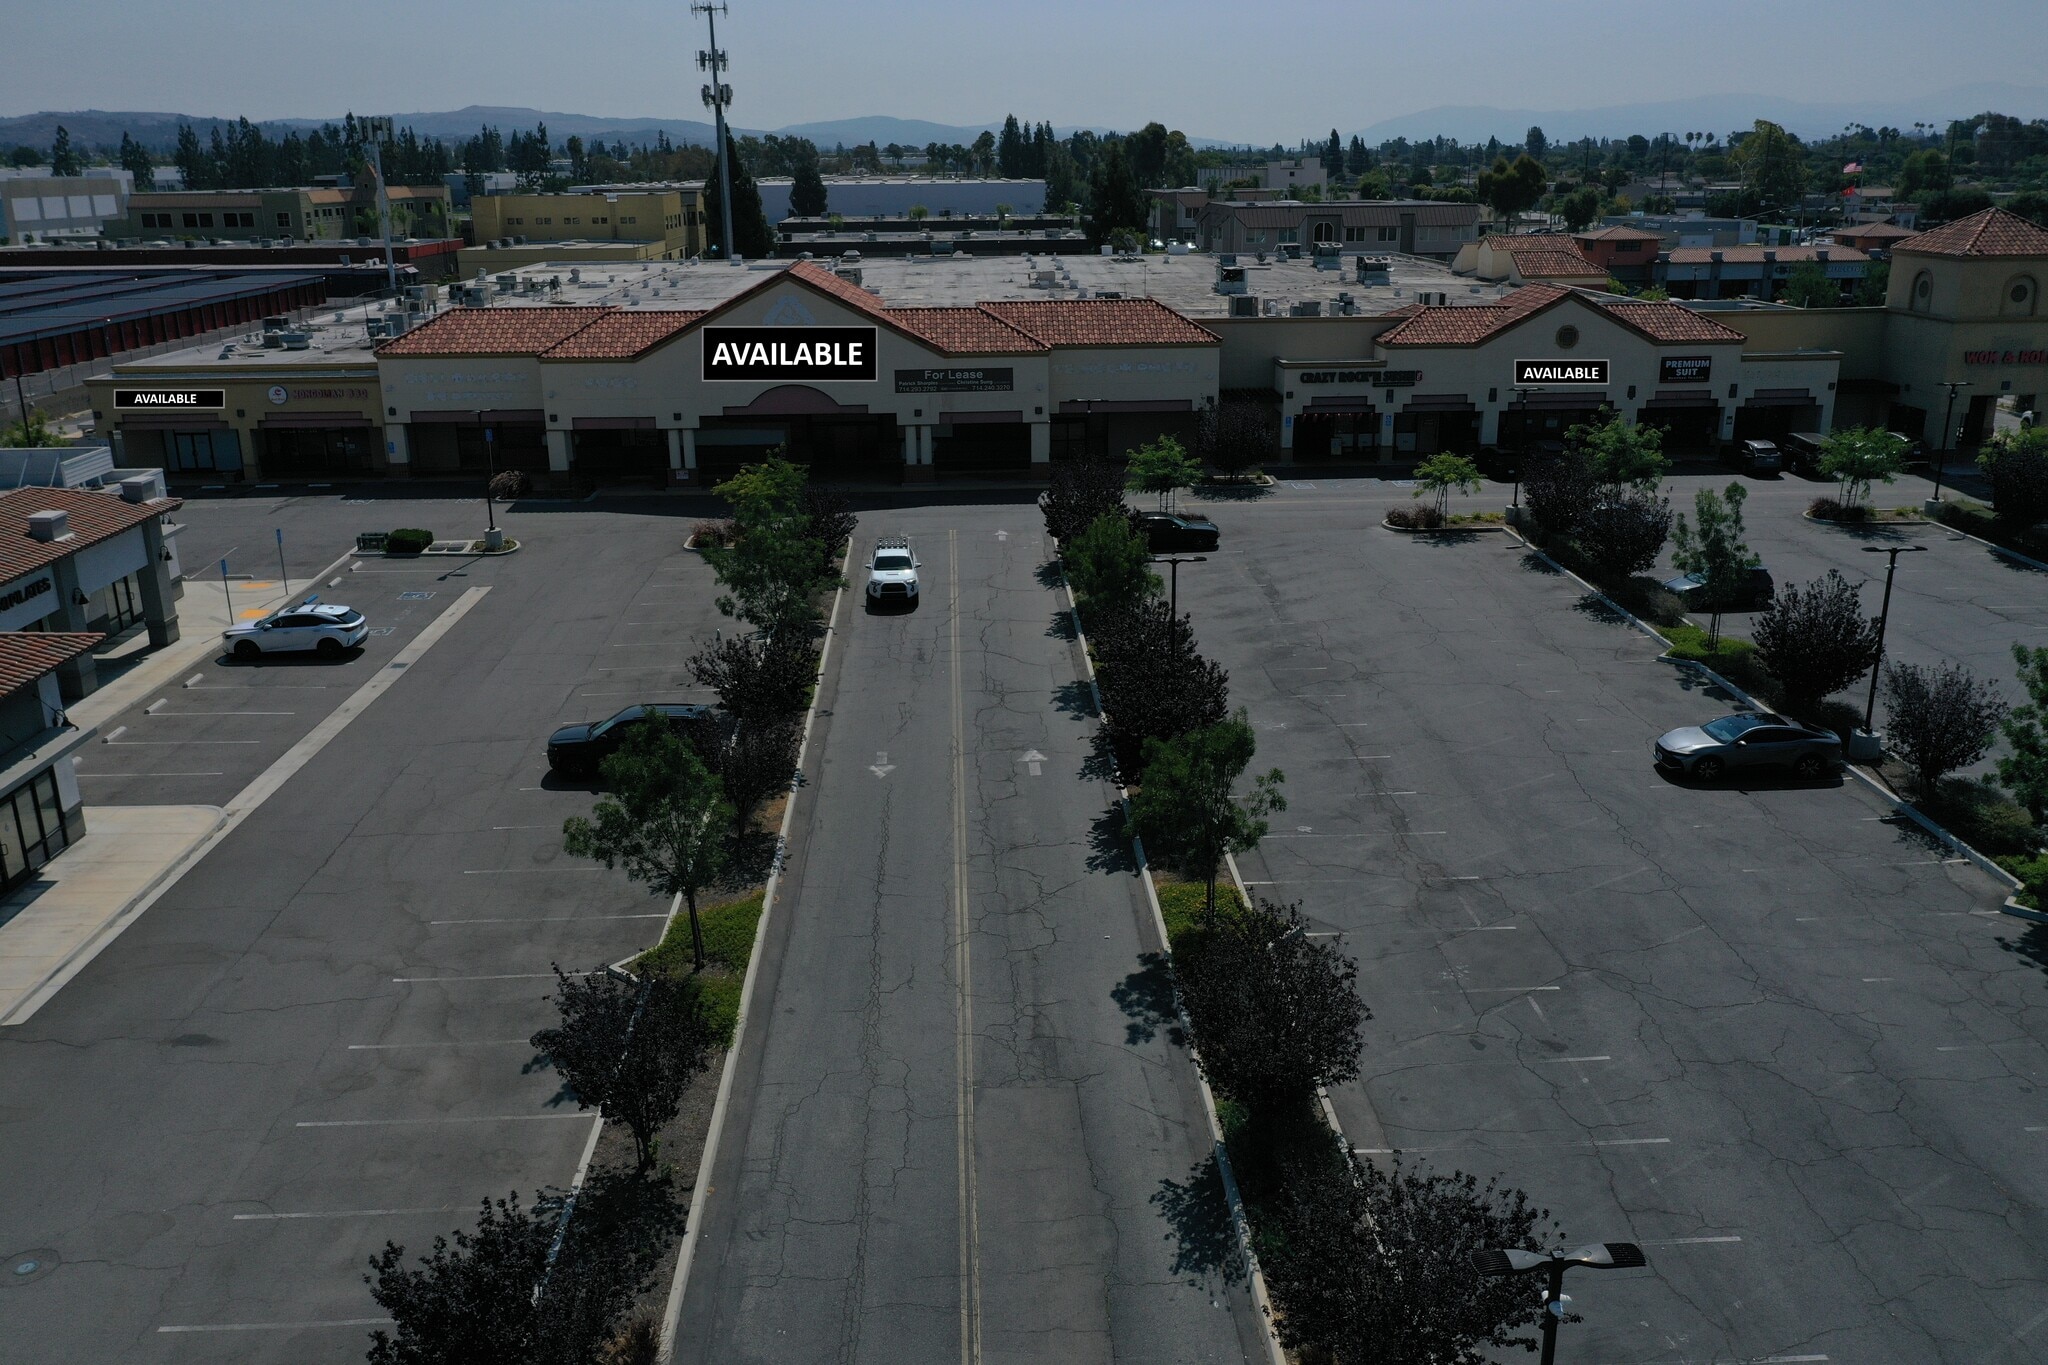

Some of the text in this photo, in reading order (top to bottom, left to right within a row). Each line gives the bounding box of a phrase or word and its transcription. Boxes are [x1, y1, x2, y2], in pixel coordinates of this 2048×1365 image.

[1965, 351, 2048, 364] WOK & ROL
[1665, 360, 1710, 368] PREMIUM
[924, 369, 984, 380] For Lease
[1300, 372, 1337, 383] CRAZY
[1675, 368, 1698, 376] SUIT
